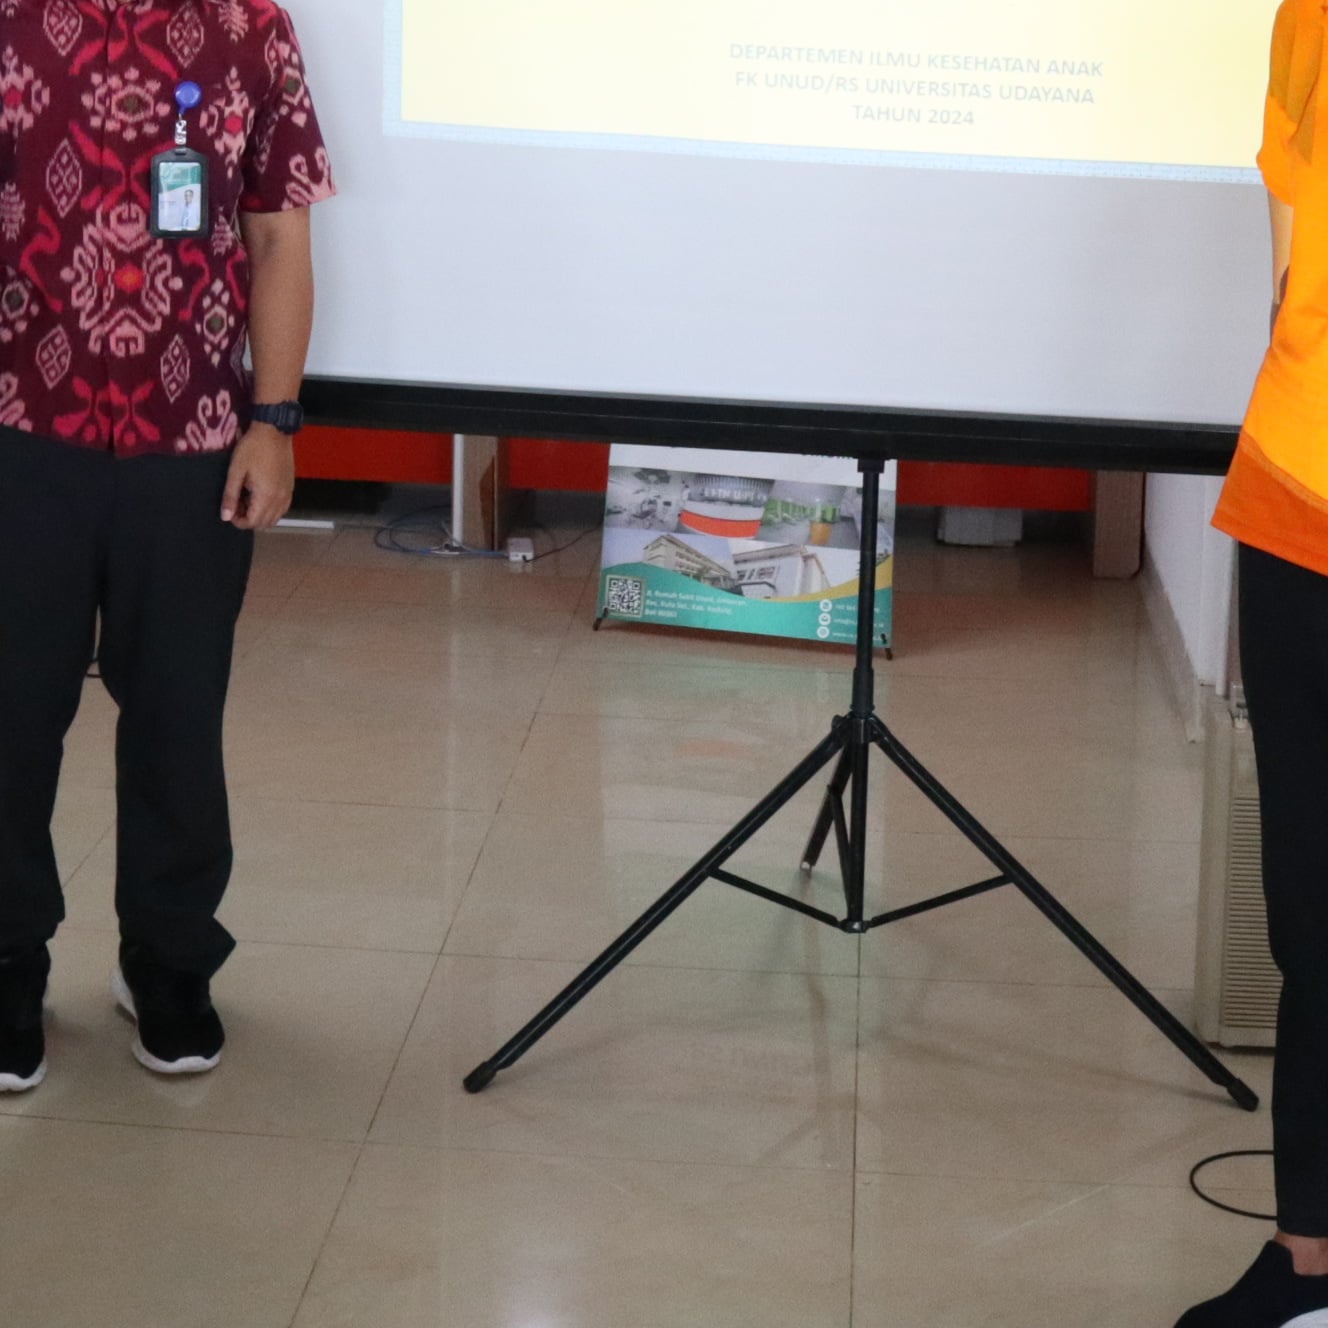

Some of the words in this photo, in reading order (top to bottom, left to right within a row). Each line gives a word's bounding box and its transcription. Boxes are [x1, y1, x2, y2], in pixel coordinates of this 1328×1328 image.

[729, 42, 864, 68] DEPARTEMEN
[869, 47, 921, 70] ILMU
[927, 50, 1042, 76] KESEHATAN
[1046, 57, 1105, 78] ANAK
[734, 71, 758, 92] FK
[763, 73, 859, 98] UNUD/RS
[865, 78, 993, 104] UNIVERSITAS
[998, 84, 1095, 105] UDAYANA
[853, 104, 922, 126] TAHUN
[928, 106, 976, 127] 2024
